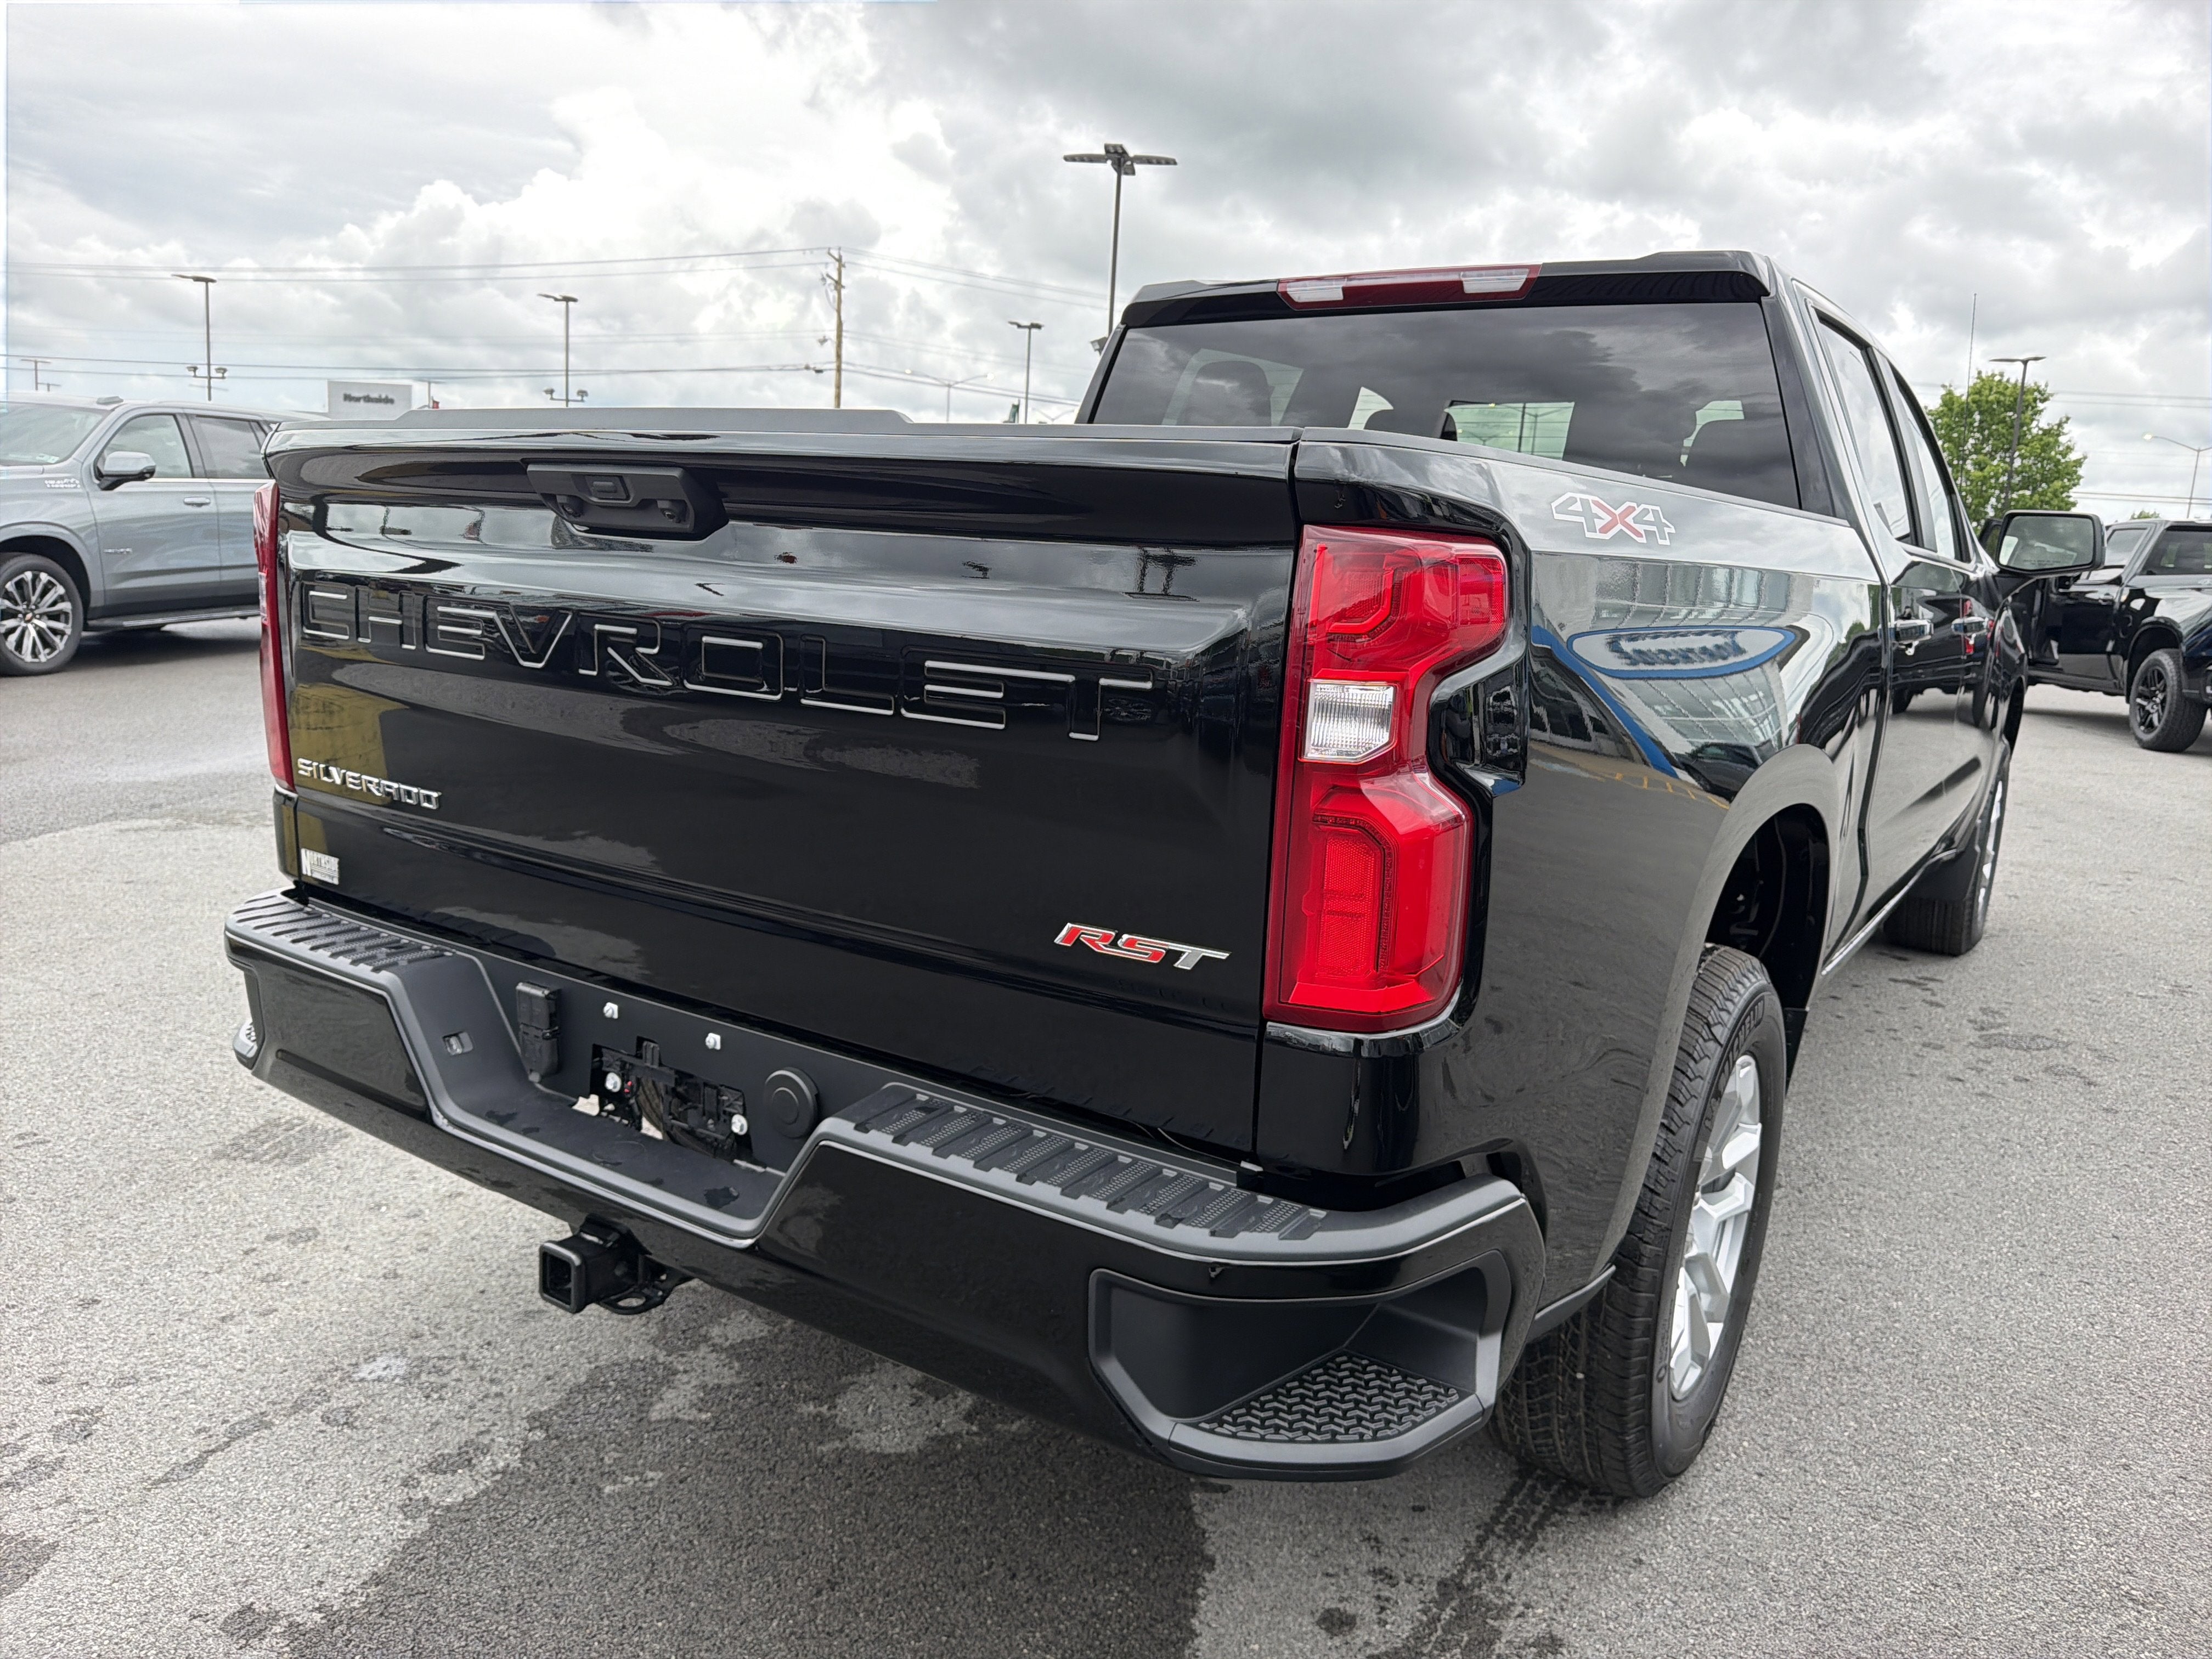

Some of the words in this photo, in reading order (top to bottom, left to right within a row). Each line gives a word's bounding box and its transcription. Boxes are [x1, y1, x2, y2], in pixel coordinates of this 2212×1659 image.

[343, 392, 394, 405] Northside
[301, 580, 1154, 741] CHEVROLET
[297, 758, 442, 810] SILVERADO
[1053, 922, 1233, 970] RST
[1717, 995, 1765, 1093] MICHELIN
